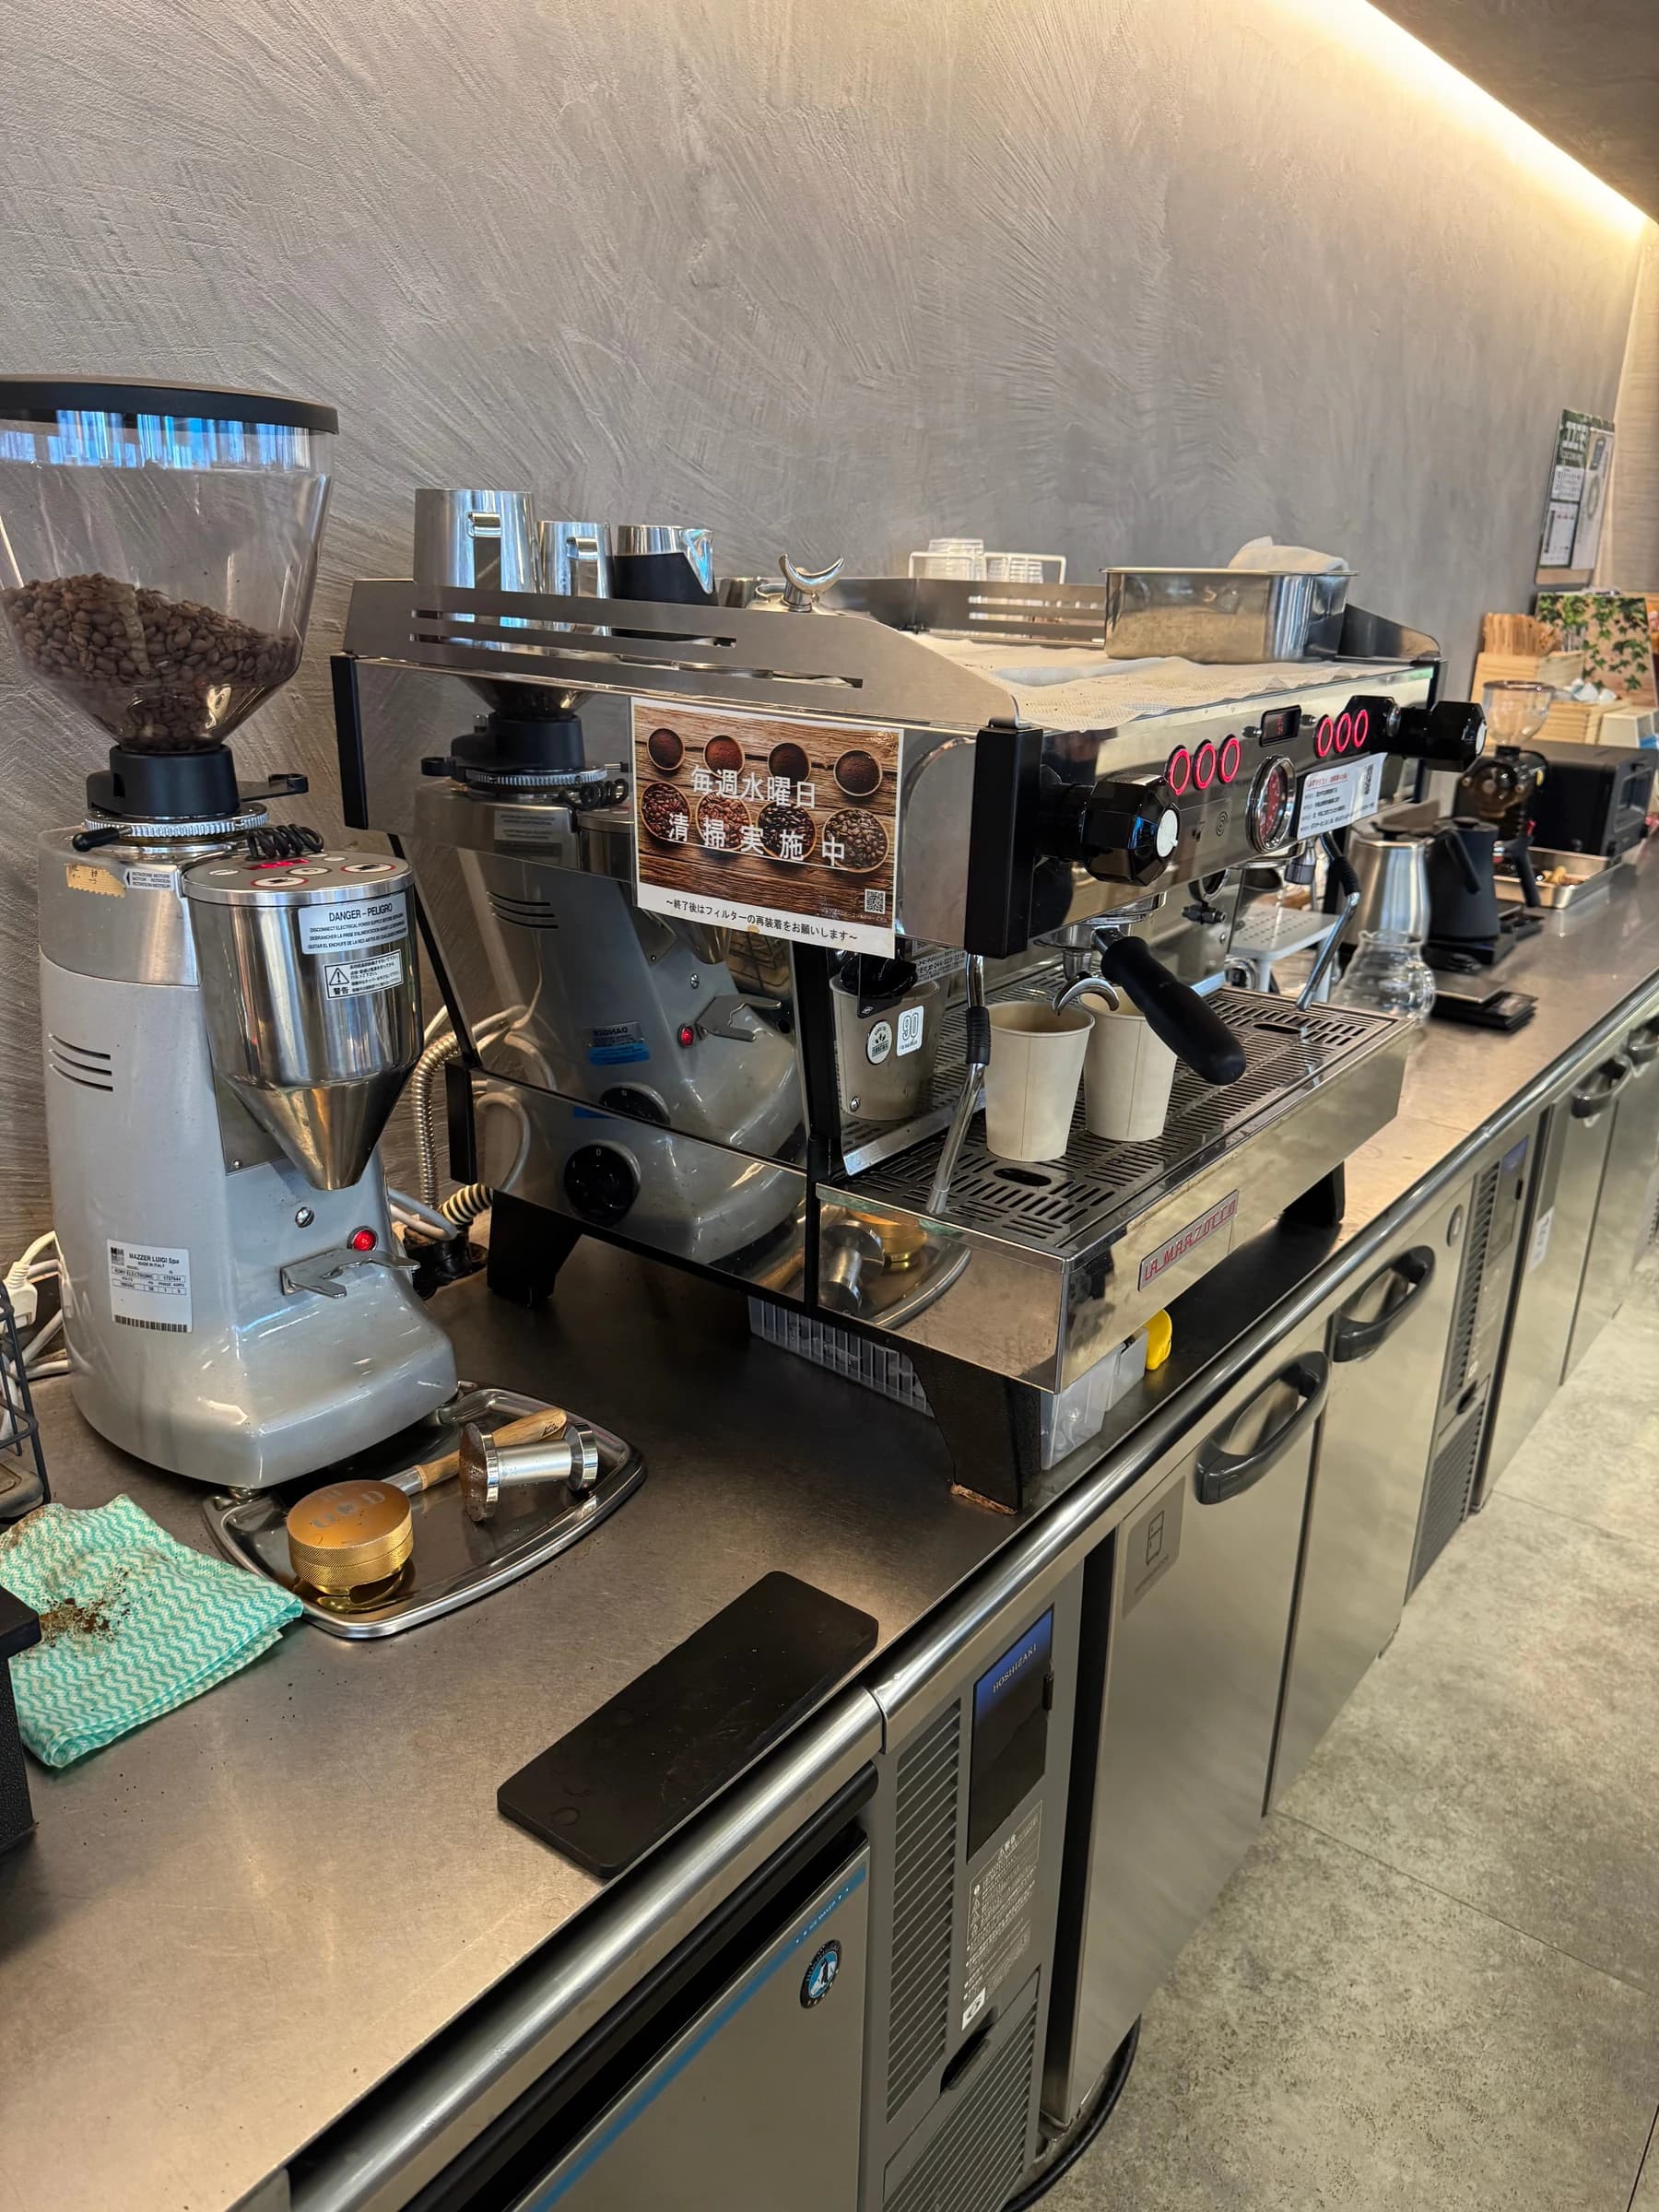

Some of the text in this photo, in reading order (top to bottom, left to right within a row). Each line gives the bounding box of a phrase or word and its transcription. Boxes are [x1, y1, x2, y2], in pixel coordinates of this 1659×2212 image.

[691, 764, 816, 809] 毎週水曜日
[668, 812, 845, 867] 清掃実施中
[329, 909, 361, 922] DANGER
[367, 902, 393, 916] PELIGRO
[902, 1012, 919, 1041] 90
[1145, 1199, 1236, 1281] LA MARZOCCO
[993, 1643, 1037, 1694] HOSHIZAKI
